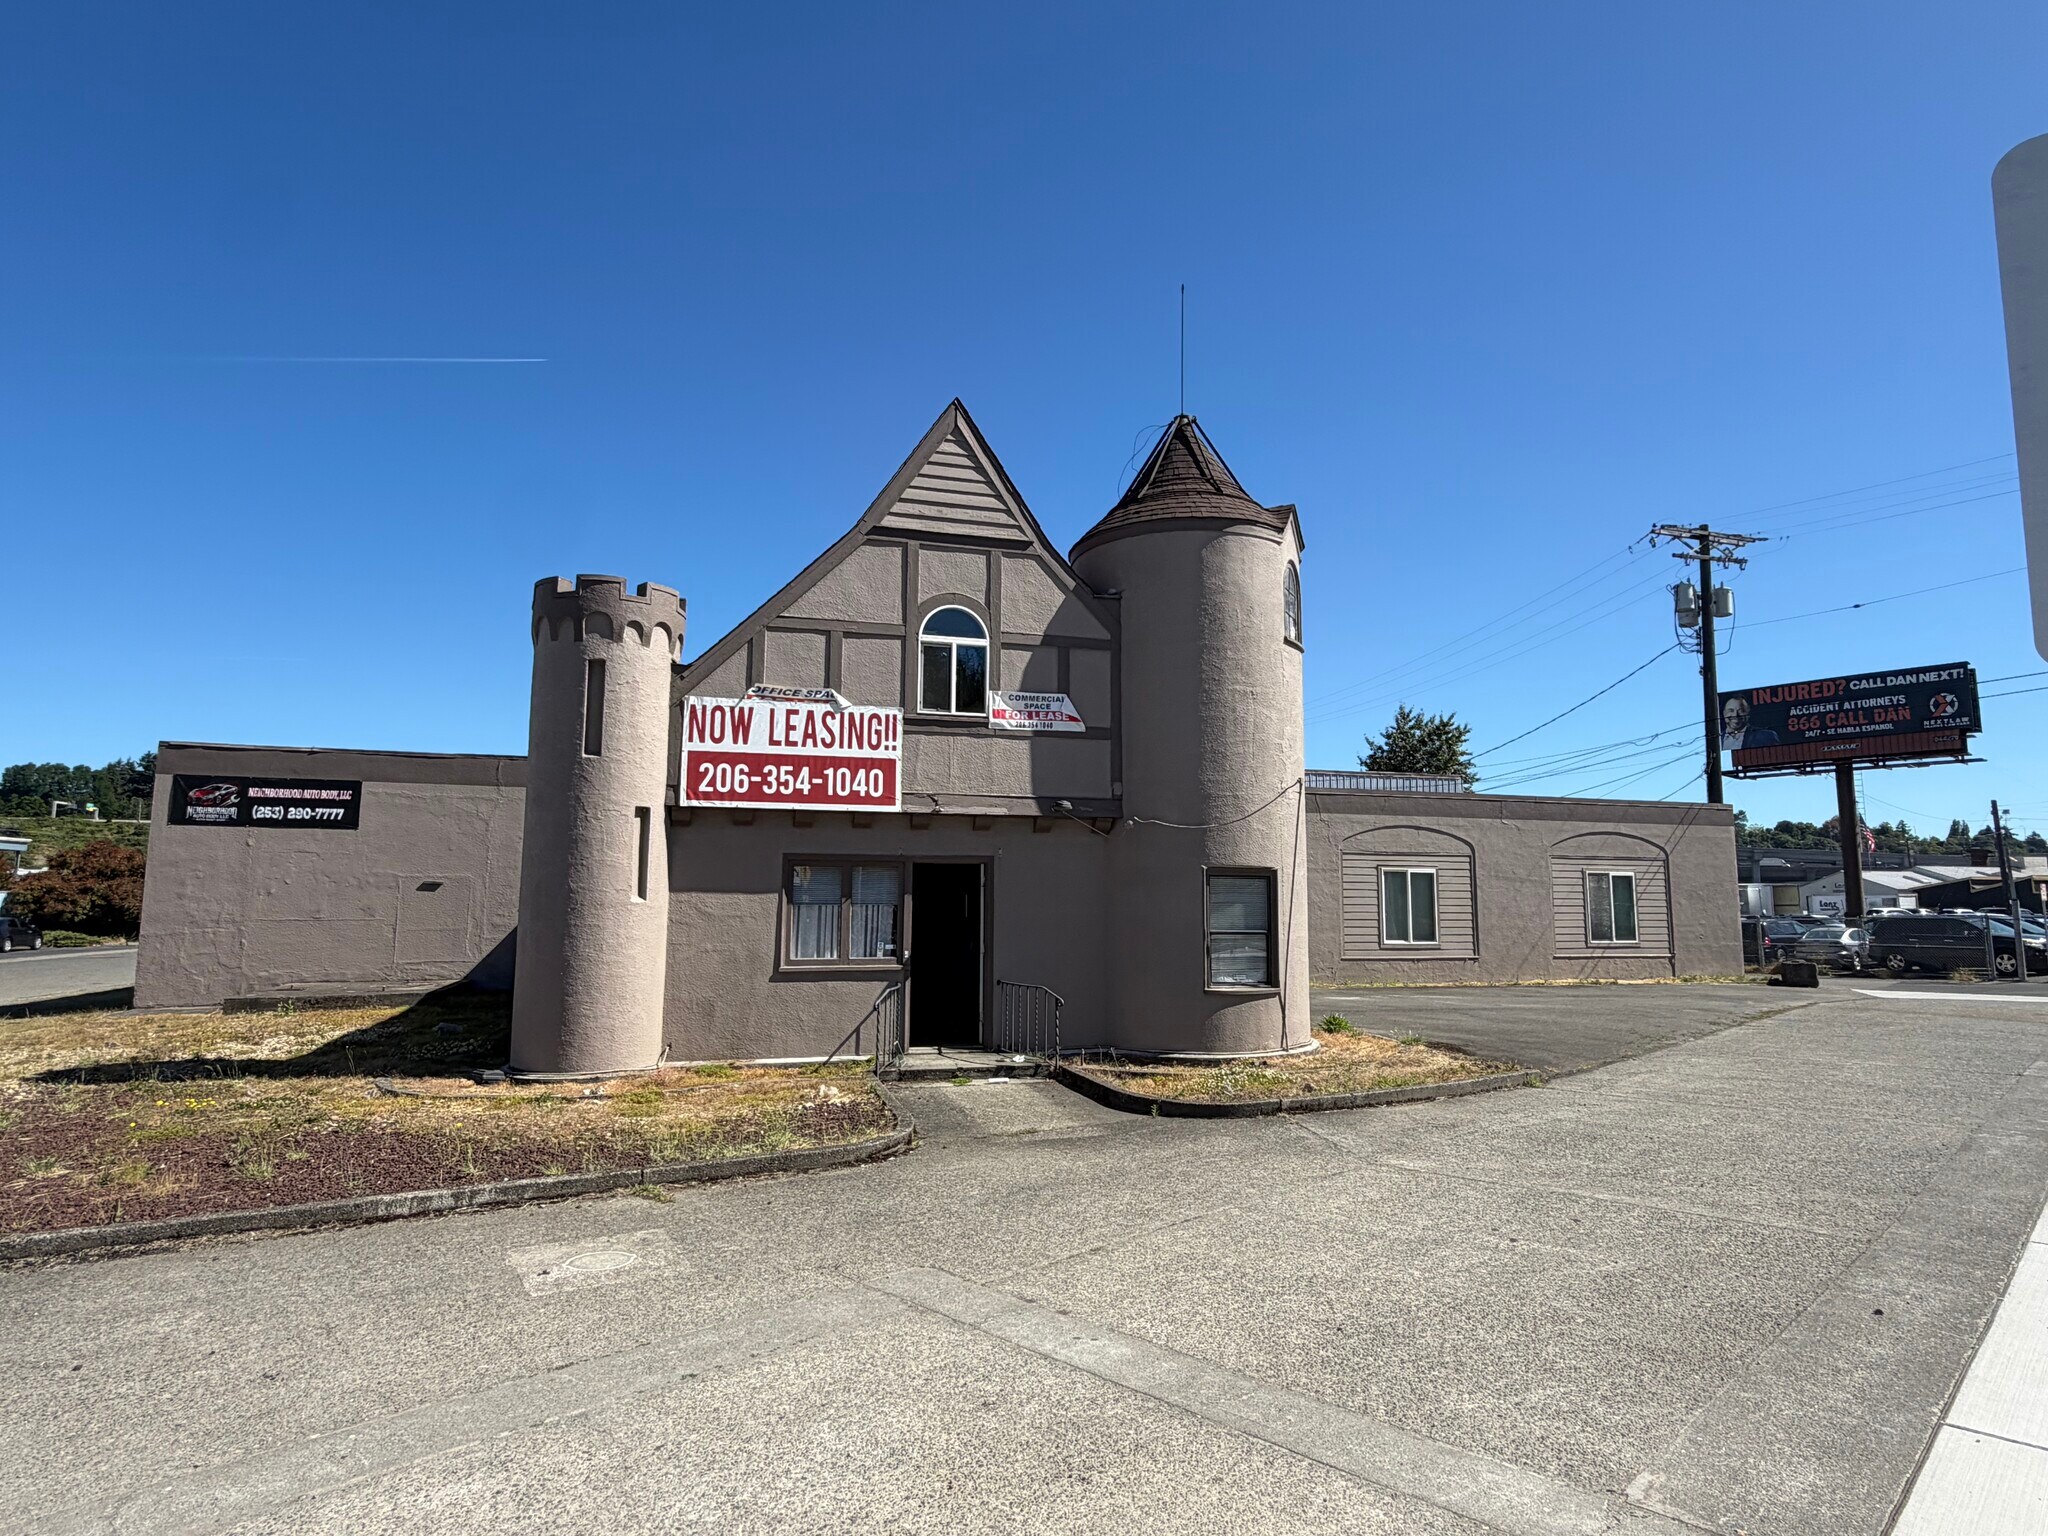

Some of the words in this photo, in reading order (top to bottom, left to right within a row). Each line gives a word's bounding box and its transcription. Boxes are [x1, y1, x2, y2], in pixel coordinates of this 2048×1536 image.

[752, 686, 802, 697] OFFICE
[1752, 679, 1847, 705] INJURED?
[1849, 677, 1885, 690] CALL
[1887, 673, 1917, 686] DAN
[1919, 668, 1964, 682] NEXT!
[1789, 701, 1840, 716] ACCIDENT
[1843, 694, 1906, 710] ATTORNEYS
[1005, 711, 1029, 720] FOR
[1032, 711, 1070, 721] LEASE
[1825, 710, 1869, 727] CALL
[1874, 706, 1912, 723] DAN
[687, 704, 754, 745] NOW
[768, 708, 898, 751] LEASING!!
[698, 762, 884, 797] 206-354-1040
[303, 789, 321, 799] AUTO
[339, 790, 353, 800] LLC
[252, 805, 284, 820] (253)
[287, 807, 345, 820] 290-7777
